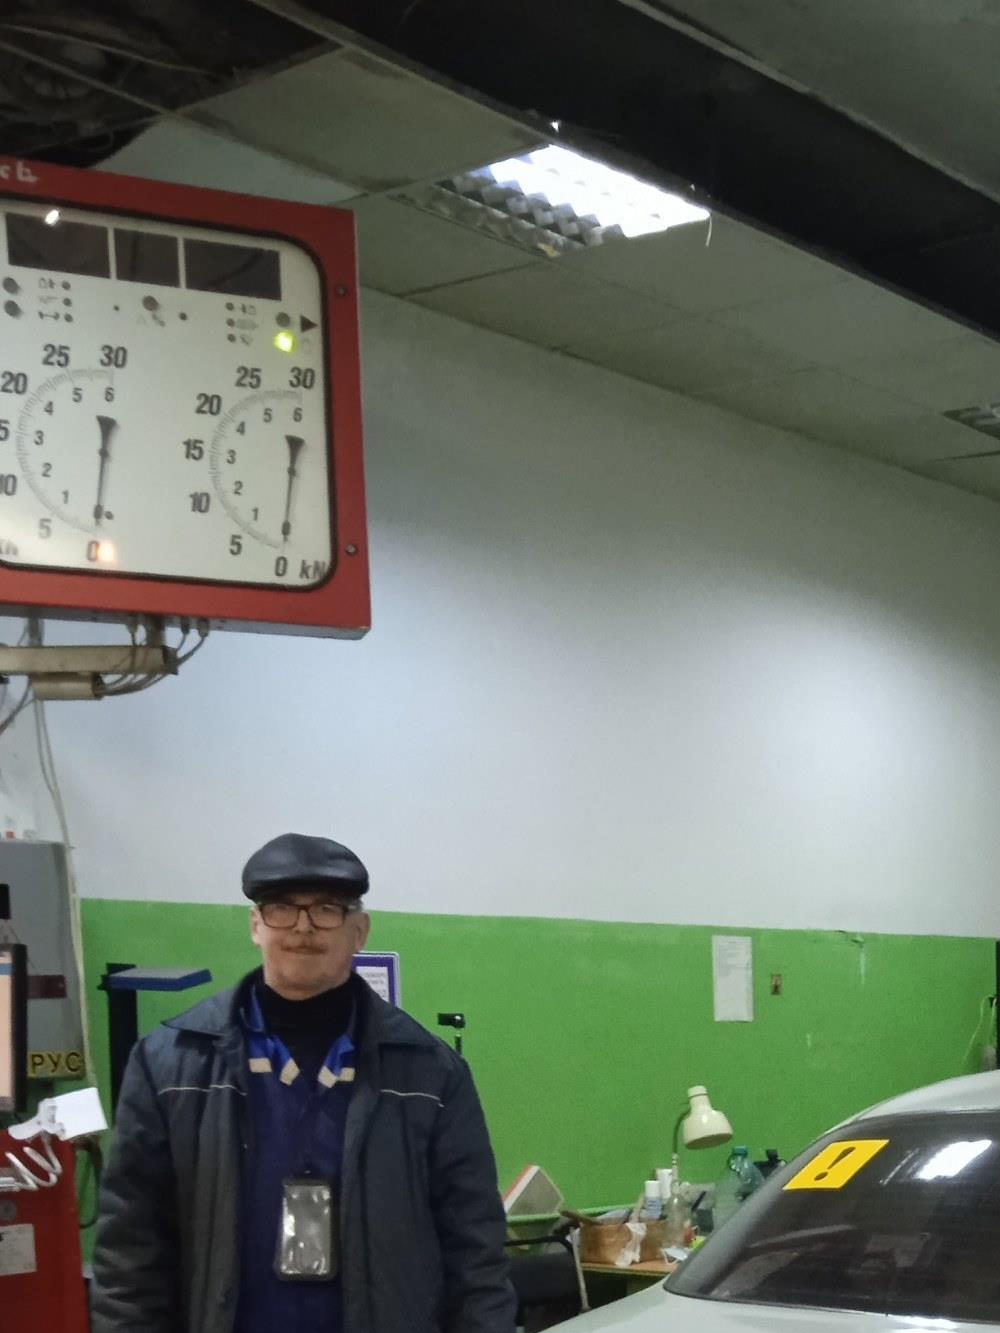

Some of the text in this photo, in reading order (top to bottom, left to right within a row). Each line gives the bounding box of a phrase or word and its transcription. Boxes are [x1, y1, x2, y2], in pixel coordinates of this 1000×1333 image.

[42, 343, 71, 369] 25
[99, 344, 128, 369] 30
[0, 371, 28, 395] 20
[235, 365, 262, 389] 25
[289, 366, 316, 390] 30
[72, 387, 82, 403] 5
[104, 387, 115, 402] 6
[44, 401, 54, 415] 4
[195, 393, 222, 416] 20
[263, 407, 273, 422] 5
[293, 407, 303, 422] 6
[236, 421, 246, 435] 4
[34, 430, 44, 446] 3
[182, 438, 205, 461] 15
[227, 449, 237, 464] 3
[42, 462, 52, 478] 2
[233, 480, 243, 495] 2
[62, 489, 69, 505] 1
[189, 492, 211, 514] 10
[252, 507, 259, 521] 1
[39, 518, 52, 539] 5
[230, 534, 242, 556] 5
[274, 556, 288, 577] 0
